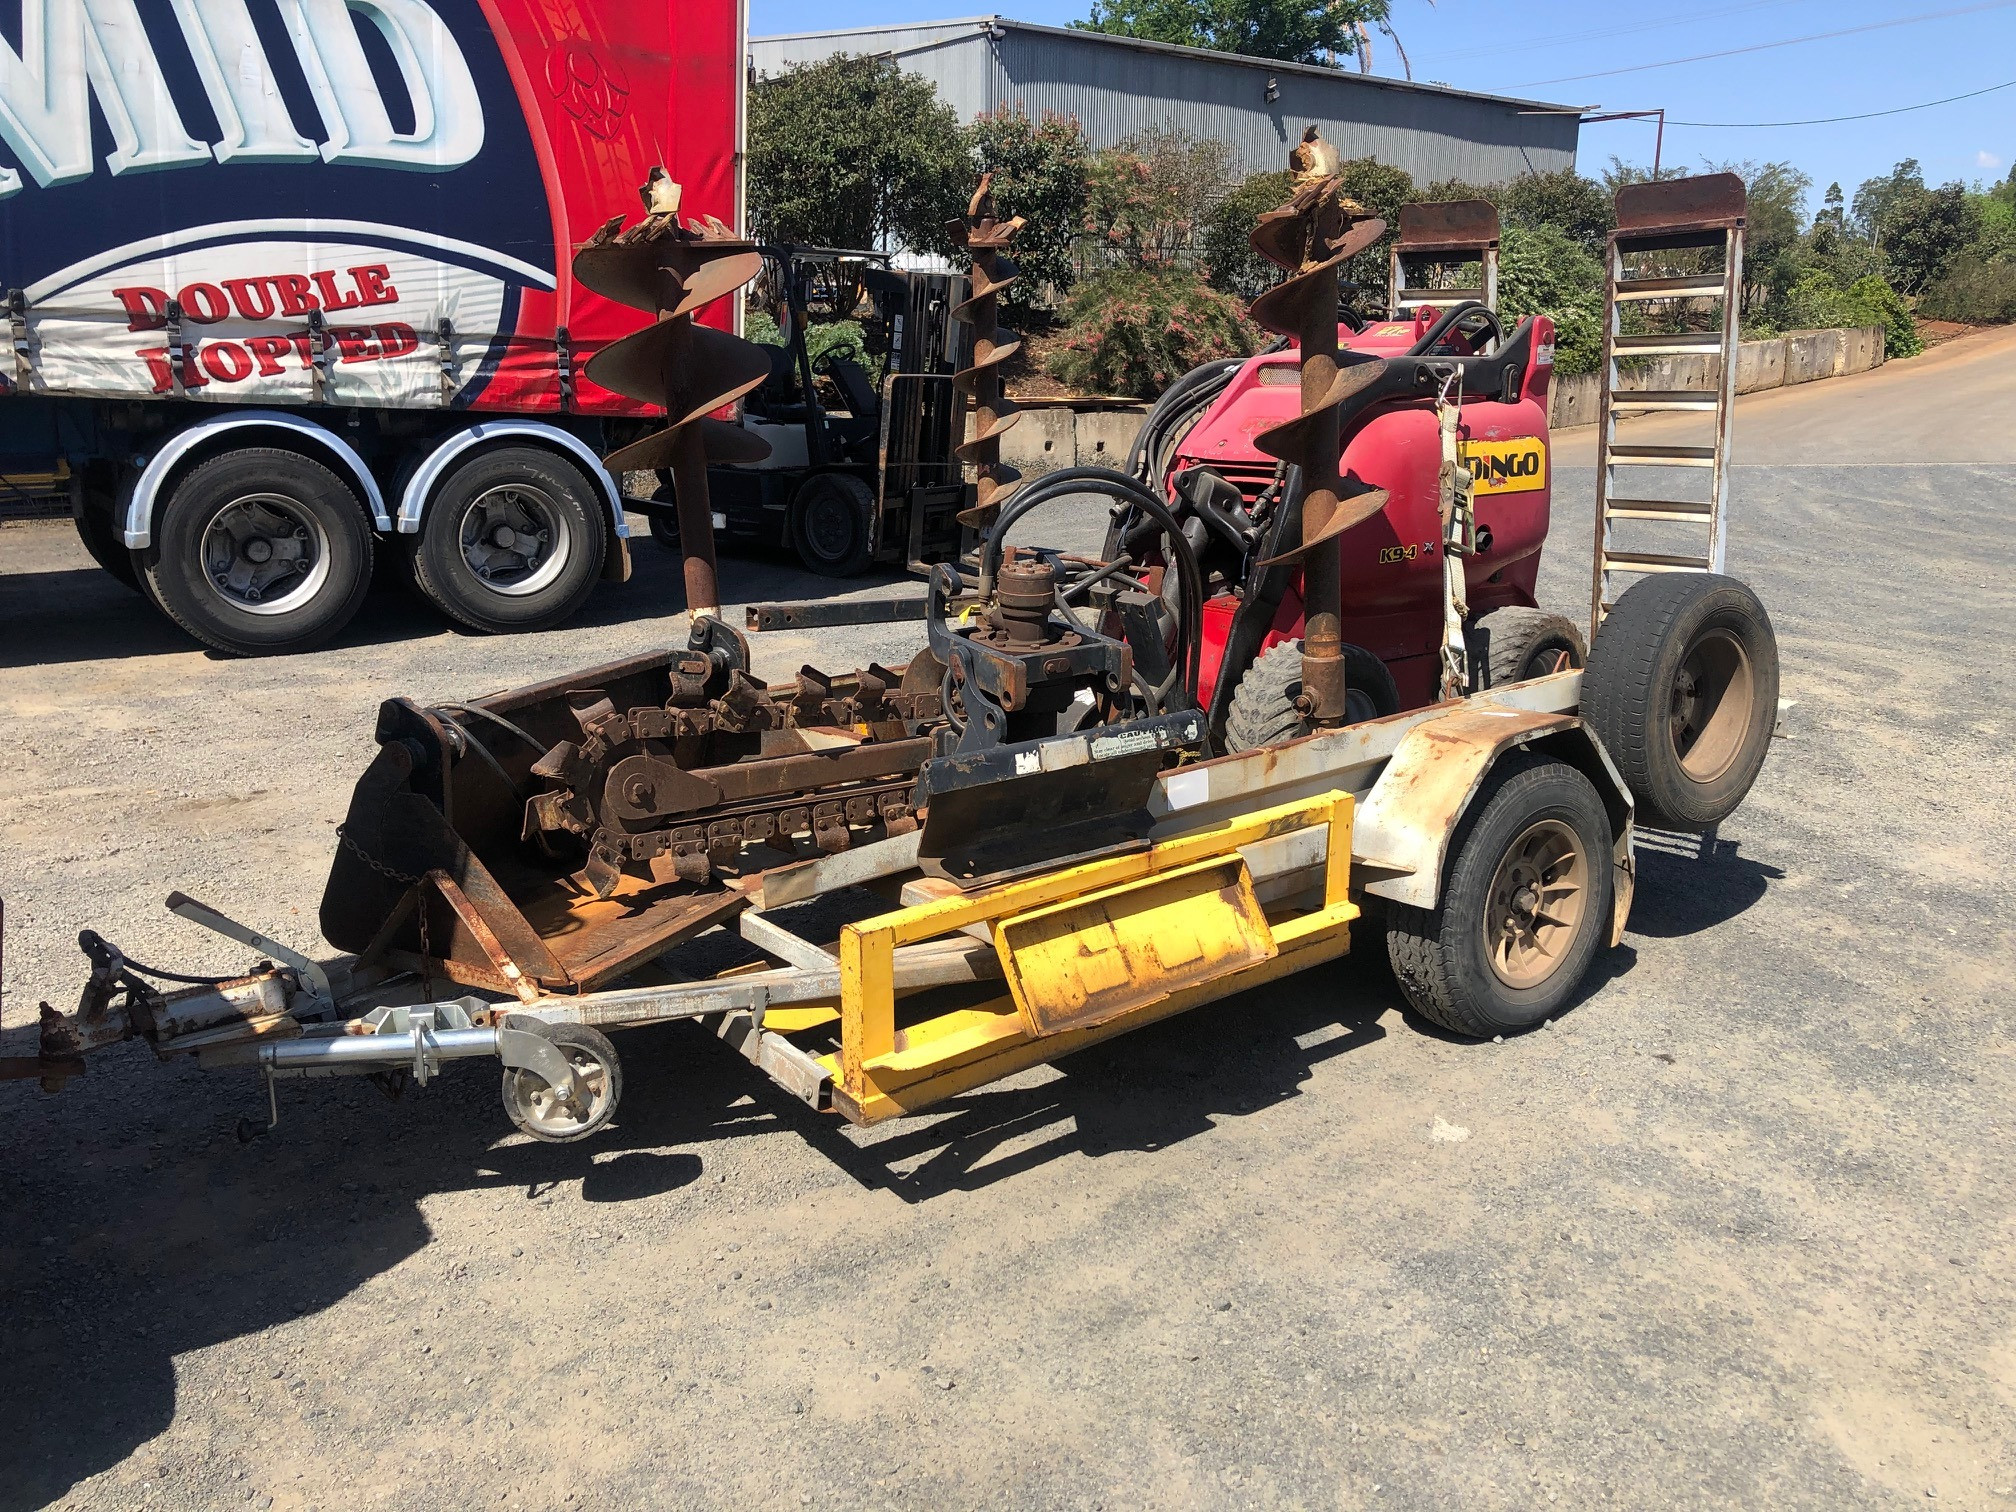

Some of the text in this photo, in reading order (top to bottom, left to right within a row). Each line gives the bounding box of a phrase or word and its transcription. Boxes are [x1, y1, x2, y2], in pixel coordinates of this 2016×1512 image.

[112, 264, 400, 333] DOUBLE
[135, 322, 419, 394] HOPPED
[1379, 544, 1418, 564] K9-4
